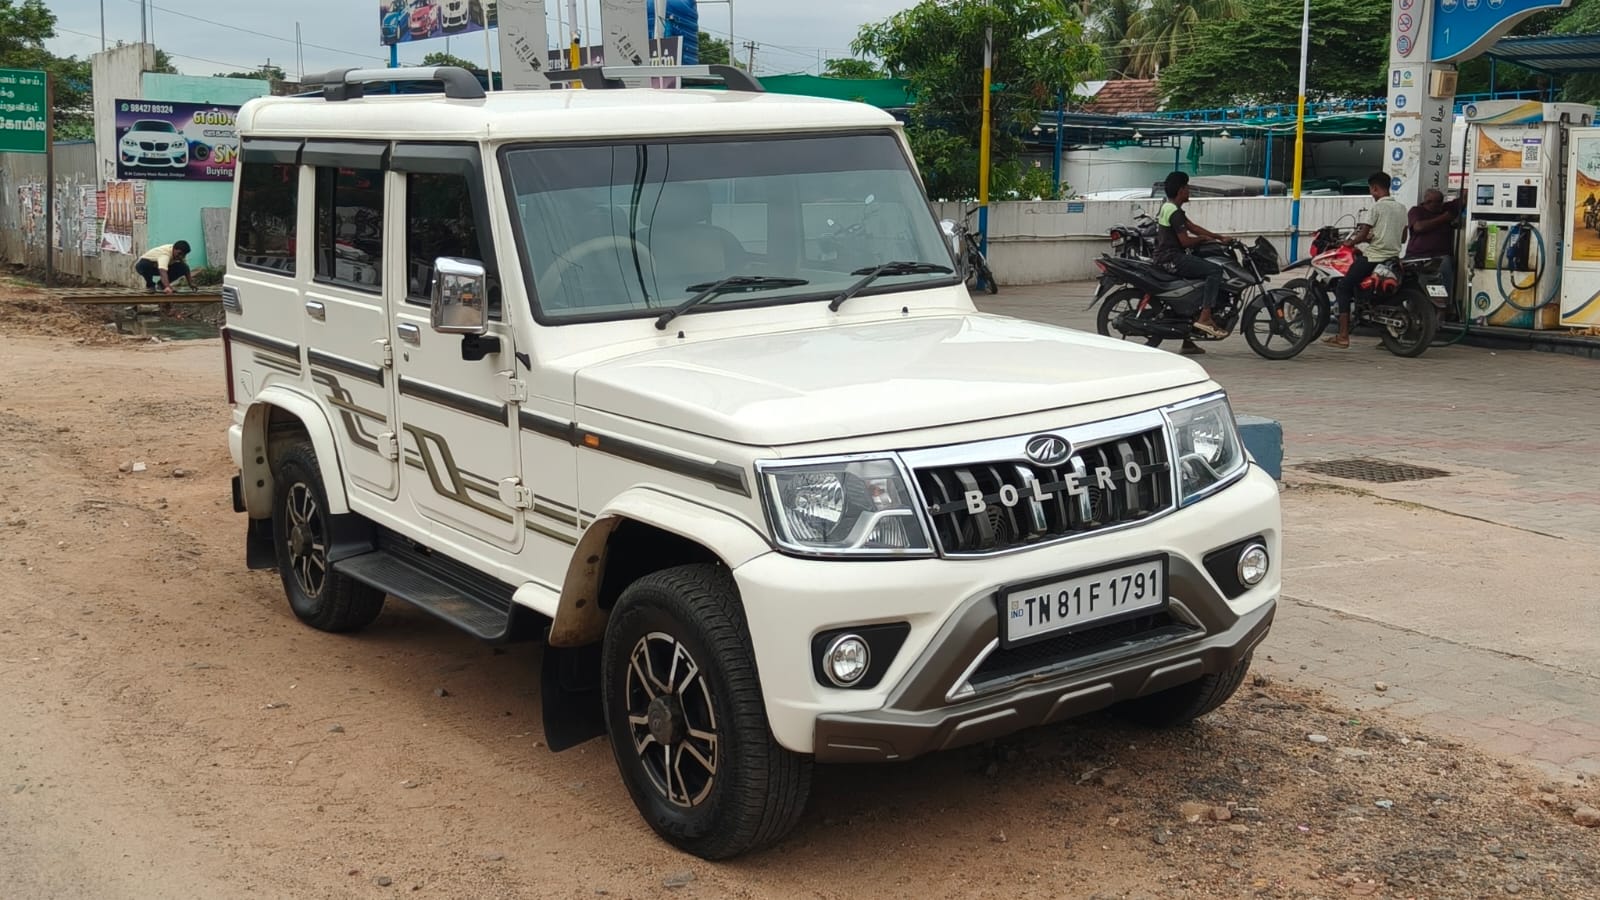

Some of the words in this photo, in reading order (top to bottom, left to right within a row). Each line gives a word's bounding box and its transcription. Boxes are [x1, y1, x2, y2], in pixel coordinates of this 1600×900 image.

[1443, 27, 1450, 45] 1
[206, 166, 233, 177] Buying
[964, 461, 1142, 515] BOLERO
[1025, 594, 1050, 626] TN
[1058, 587, 1081, 618] 81
[1089, 582, 1101, 612] F
[1109, 569, 1157, 606] 1791
[1011, 608, 1024, 619] IND
